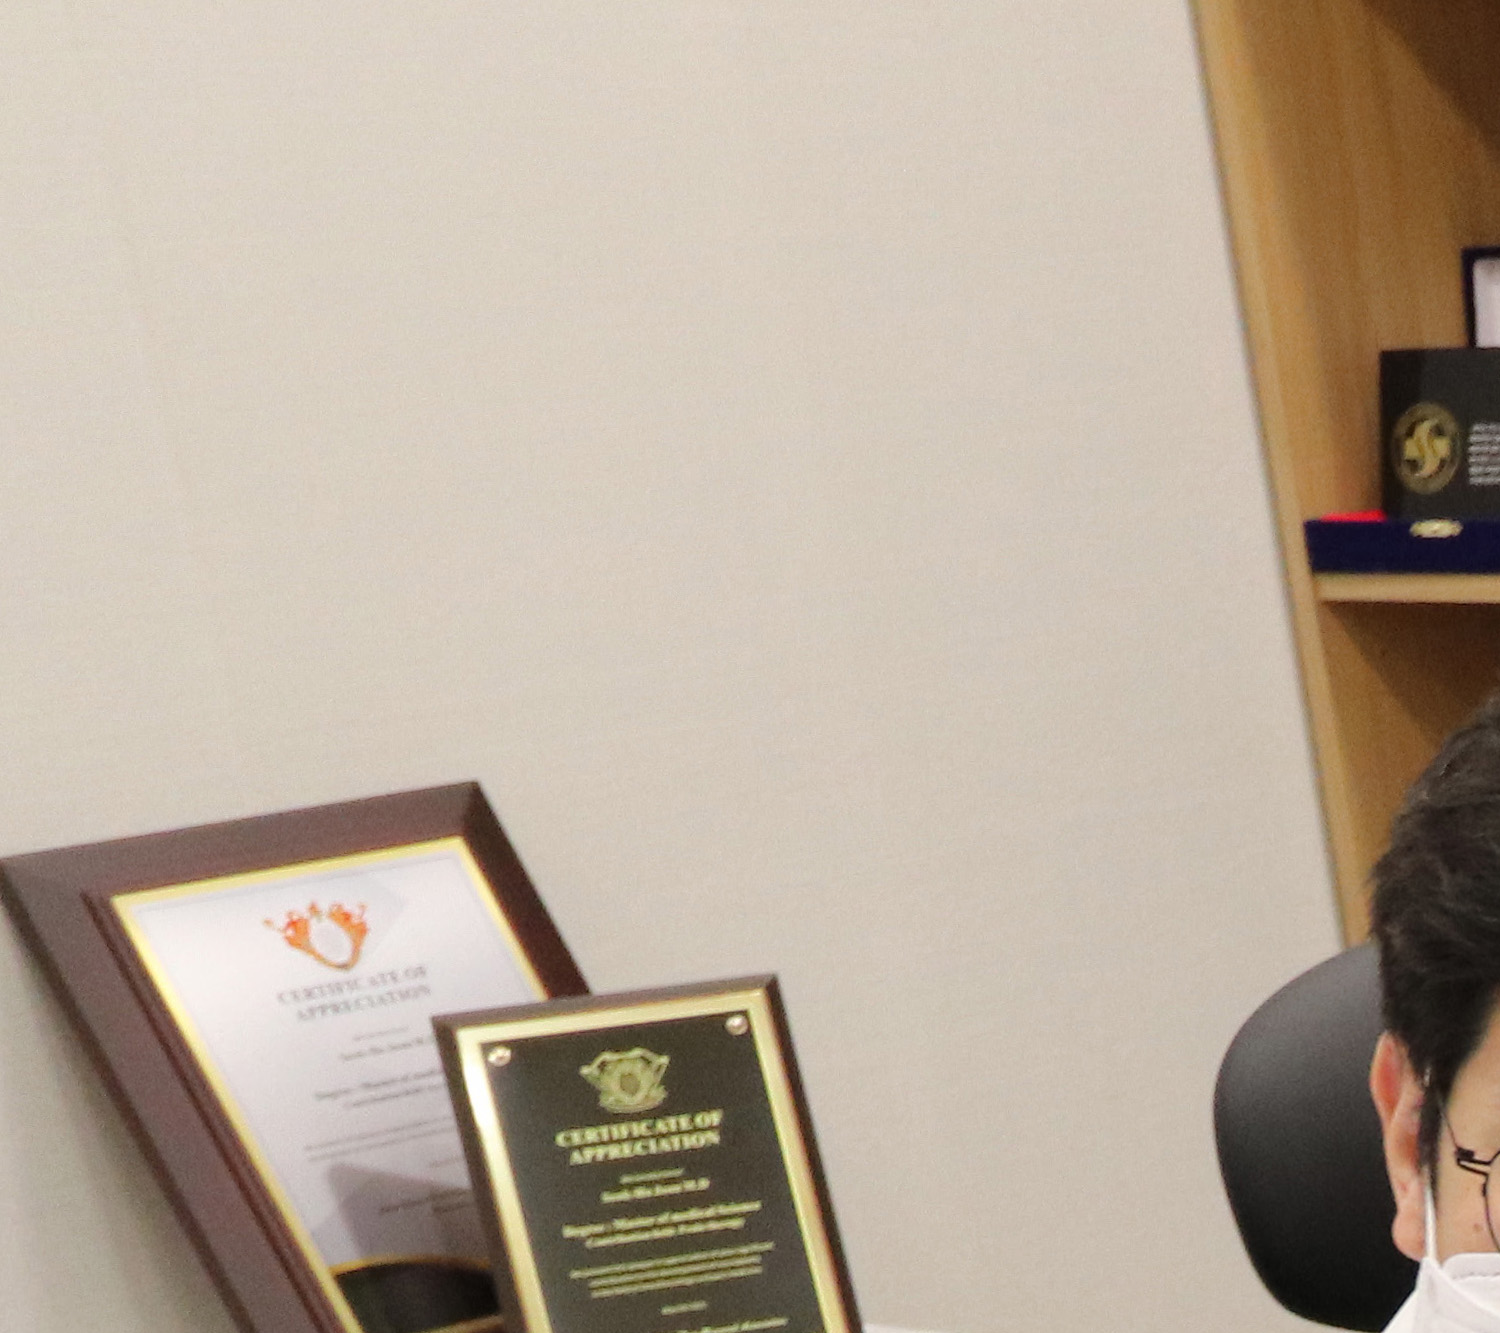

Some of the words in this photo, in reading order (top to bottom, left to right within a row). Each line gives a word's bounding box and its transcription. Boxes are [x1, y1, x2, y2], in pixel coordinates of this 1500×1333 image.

[554, 1112, 694, 1148] CERTIFICATE
[694, 1108, 724, 1127] OF
[569, 1129, 721, 1166] APPRECIATION
